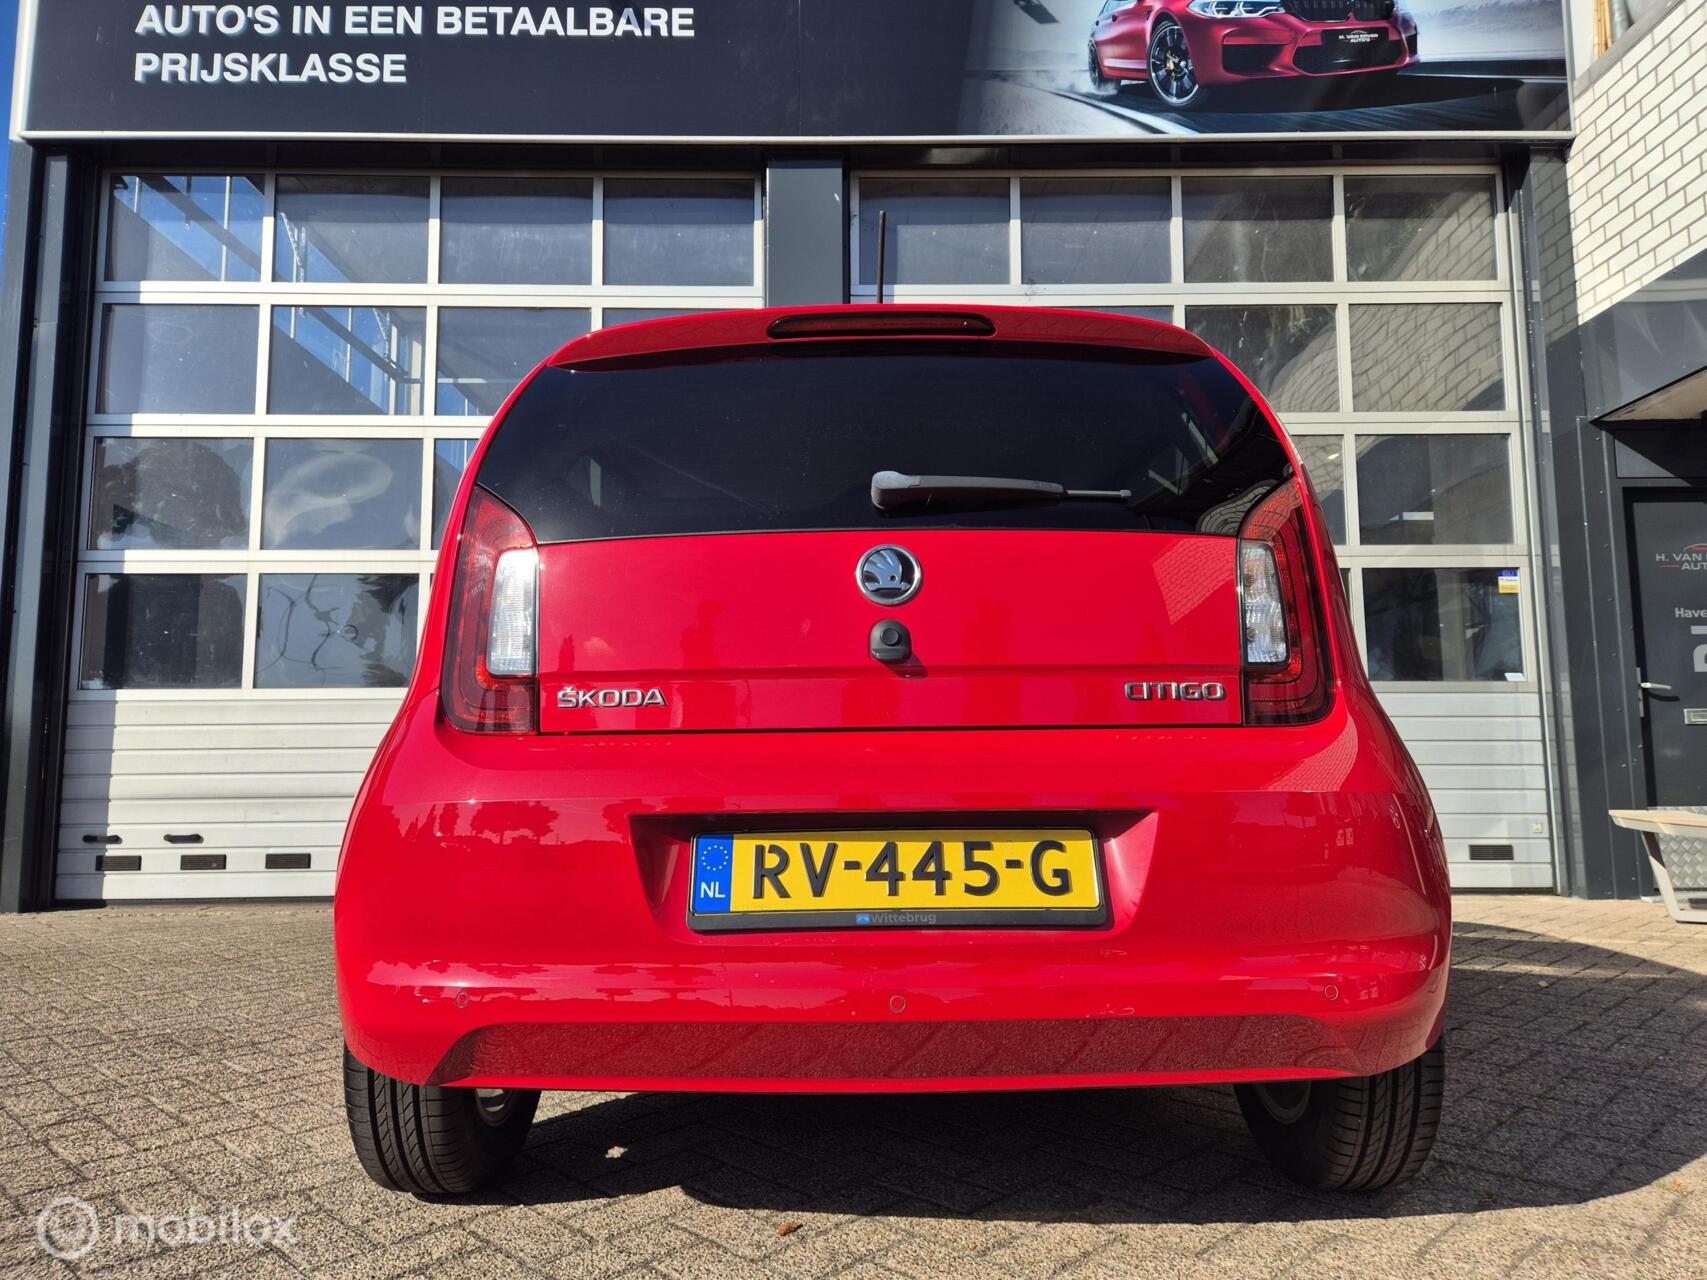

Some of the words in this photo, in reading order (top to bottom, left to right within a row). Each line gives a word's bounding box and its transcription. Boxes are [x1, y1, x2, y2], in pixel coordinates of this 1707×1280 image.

[135, 4, 280, 36] AUTO'S
[291, 6, 328, 35] IN
[344, 6, 424, 35] EEN
[436, 7, 695, 37] BETAALBARE
[134, 52, 408, 83] PRIJSKLASSE
[1655, 553, 1670, 562] H.
[1672, 553, 1703, 561] VAN
[557, 686, 666, 708] ŠKODA
[1123, 682, 1226, 701] CITIGO
[752, 838, 1072, 900] RV-445-G
[700, 881, 726, 899] NL
[870, 912, 937, 925] Wittebrug
